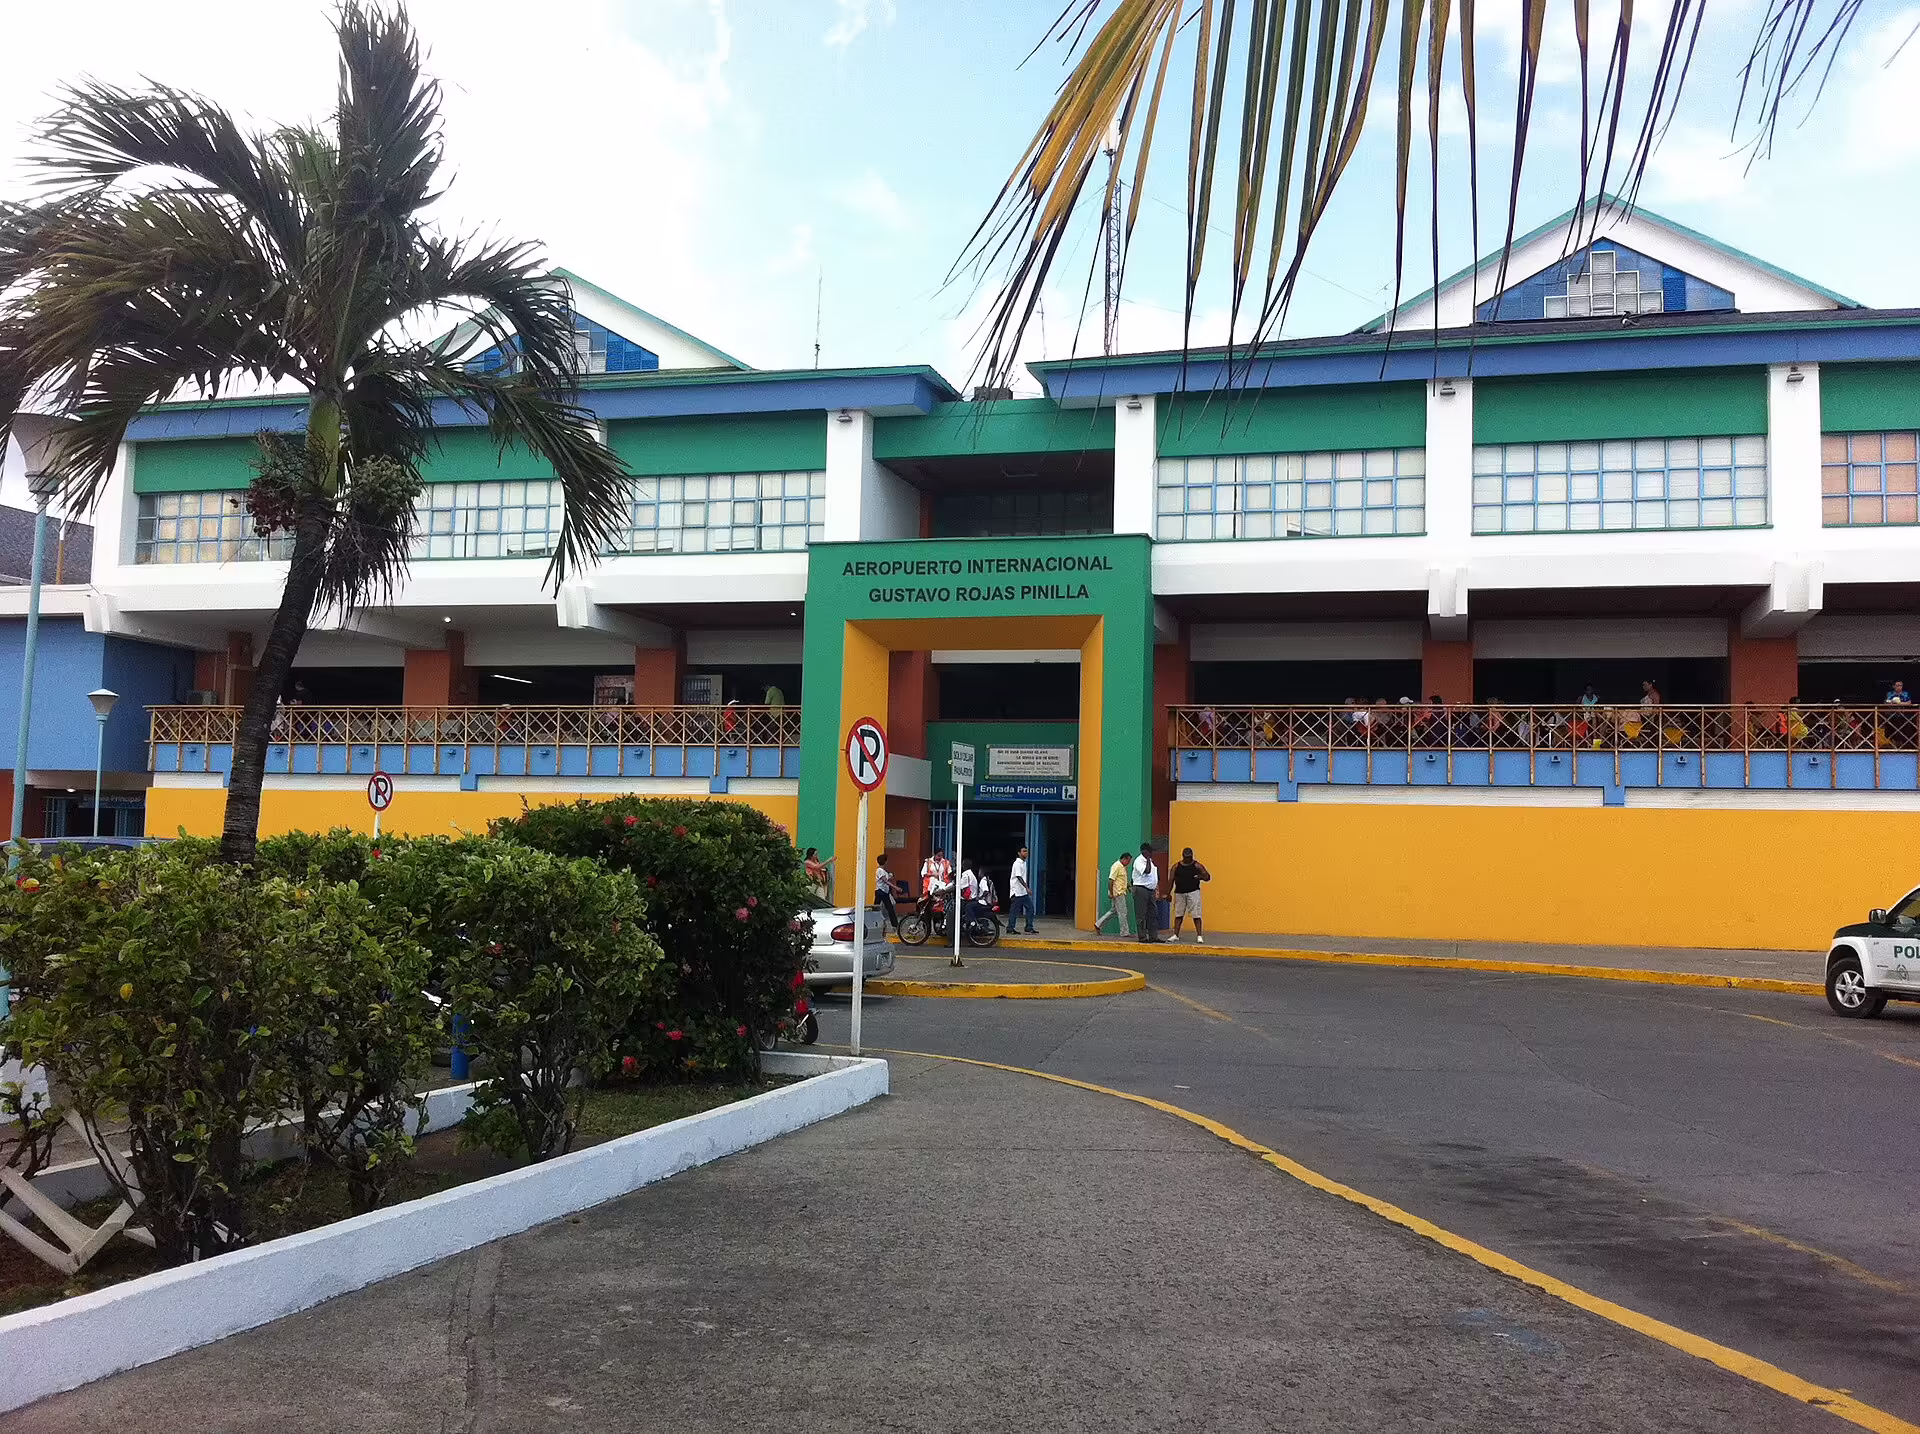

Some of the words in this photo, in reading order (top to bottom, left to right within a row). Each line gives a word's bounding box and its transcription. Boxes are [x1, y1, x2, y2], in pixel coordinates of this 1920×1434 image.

[842, 560, 963, 576] AEROPUERTO
[967, 556, 1114, 575] INTERNACIONAL
[869, 587, 950, 602] GUSTAVO
[955, 585, 1015, 601] ROJAS
[1020, 584, 1090, 600] PINILLA
[980, 784, 1015, 793] Entrada
[1017, 785, 1057, 795] Principal
